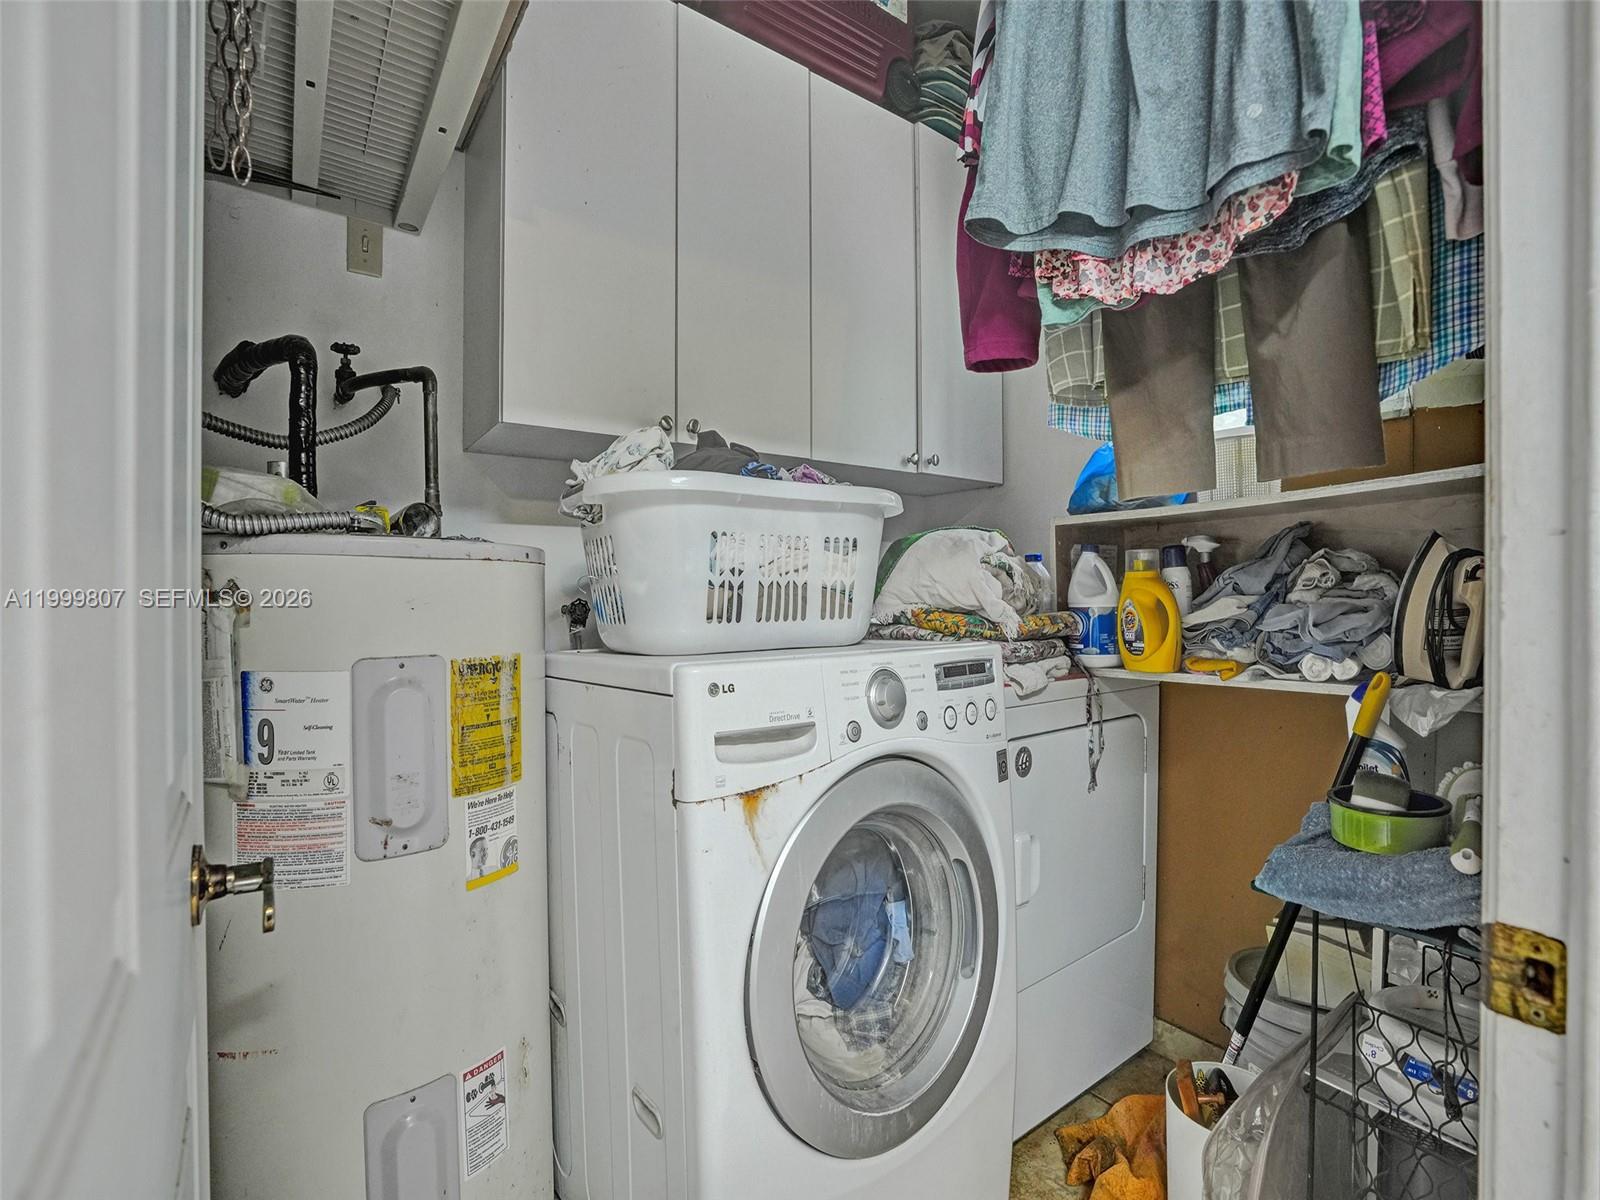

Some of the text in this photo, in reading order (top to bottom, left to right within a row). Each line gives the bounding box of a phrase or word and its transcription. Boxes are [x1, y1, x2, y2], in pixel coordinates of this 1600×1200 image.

[722, 684, 735, 694] LG
[769, 714, 786, 723] Direct
[786, 712, 801, 721] Drive
[257, 718, 275, 766] 9
[467, 800, 484, 810] We're
[485, 795, 497, 806] Here
[497, 793, 503, 803] To
[468, 815, 515, 839] 1-800-431-1549
[473, 1054, 502, 1076] DANGER
